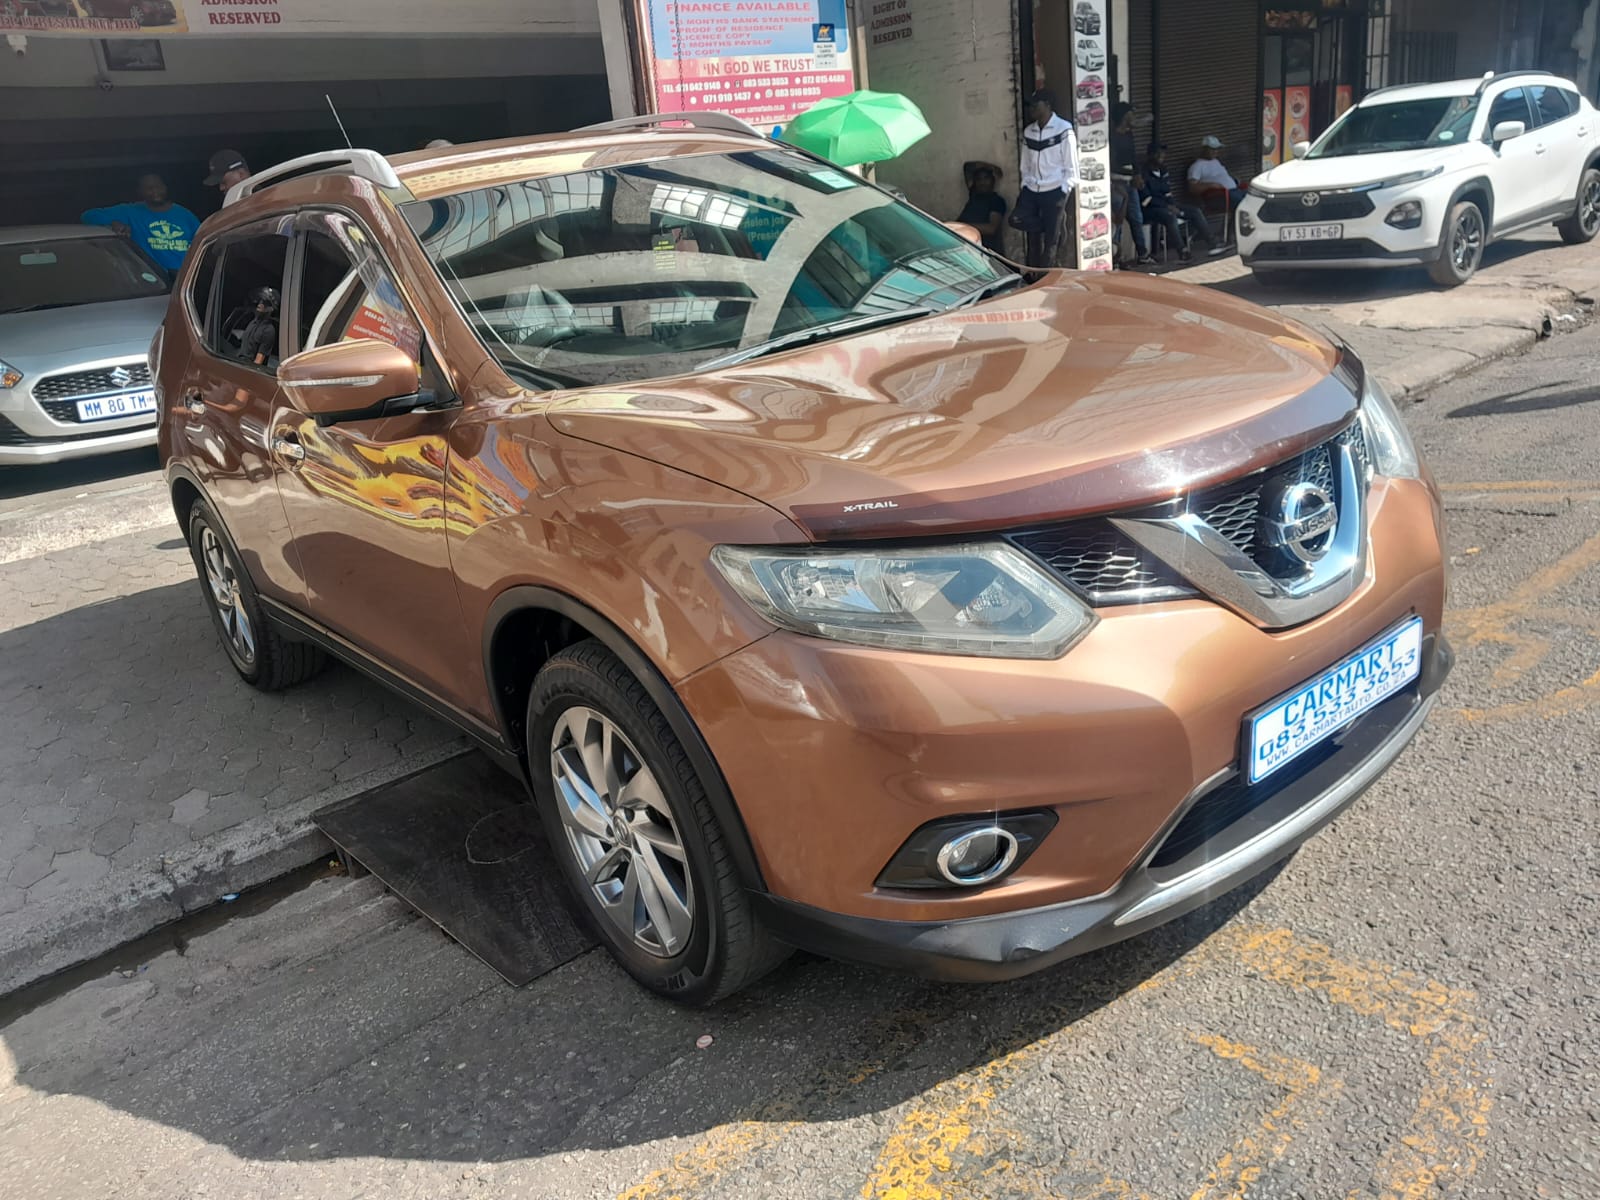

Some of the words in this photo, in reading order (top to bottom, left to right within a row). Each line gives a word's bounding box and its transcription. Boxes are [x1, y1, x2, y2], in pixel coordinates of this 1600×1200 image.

[666, 3, 731, 12] FNANCE
[736, 2, 811, 11] AVAILABLE
[203, 12, 281, 24] RESERVED
[871, 12, 912, 30] ADMISSION
[873, 27, 912, 45] RESERVED
[724, 61, 749, 74] GOD
[753, 60, 770, 72] WE
[1296, 229, 1306, 238] 53
[84, 402, 103, 417] MM
[109, 397, 126, 412] 80
[128, 394, 147, 409] TM
[843, 500, 898, 513] X-TRAIL
[1293, 511, 1336, 539] NISSAN
[1284, 638, 1398, 727] CARMART
[1259, 719, 1306, 761] 083
[1313, 687, 1357, 725] 533
[1362, 648, 1416, 693] 3653
